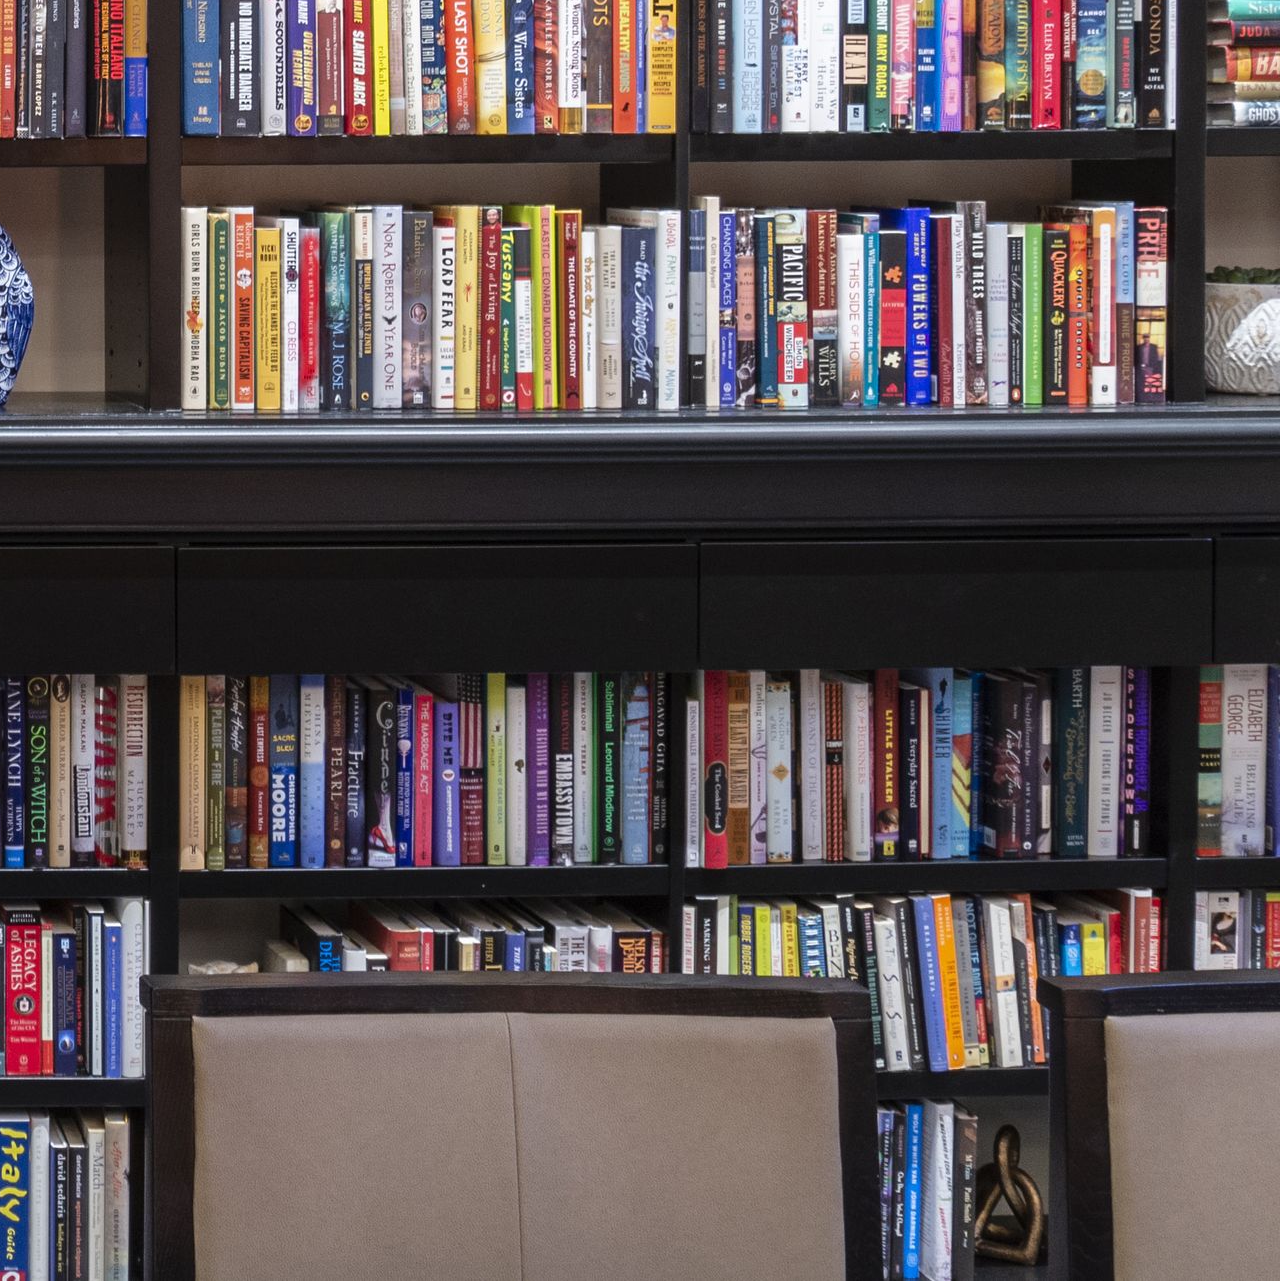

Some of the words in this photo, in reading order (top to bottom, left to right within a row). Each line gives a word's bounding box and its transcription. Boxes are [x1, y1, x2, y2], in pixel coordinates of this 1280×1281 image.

[239, 1, 252, 16] NO
[239, 19, 252, 73] IMMEDIATE
[239, 75, 252, 111] DANGER
[783, 244, 804, 301] PACIFIC
[239, 298, 249, 328] SAVING
[239, 331, 249, 380] CAPITALISM
[1227, 694, 1243, 734] GEORGE
[1248, 688, 1263, 743] ELIZABETH
[272, 774, 286, 843] MOORE
[287, 774, 295, 841] CHRISTOPHER
[556, 754, 572, 846] EMBASSYTOWN
[10, 930, 20, 941] of
[23, 929, 37, 991] LEGACY
[11, 944, 22, 991] ASHES
